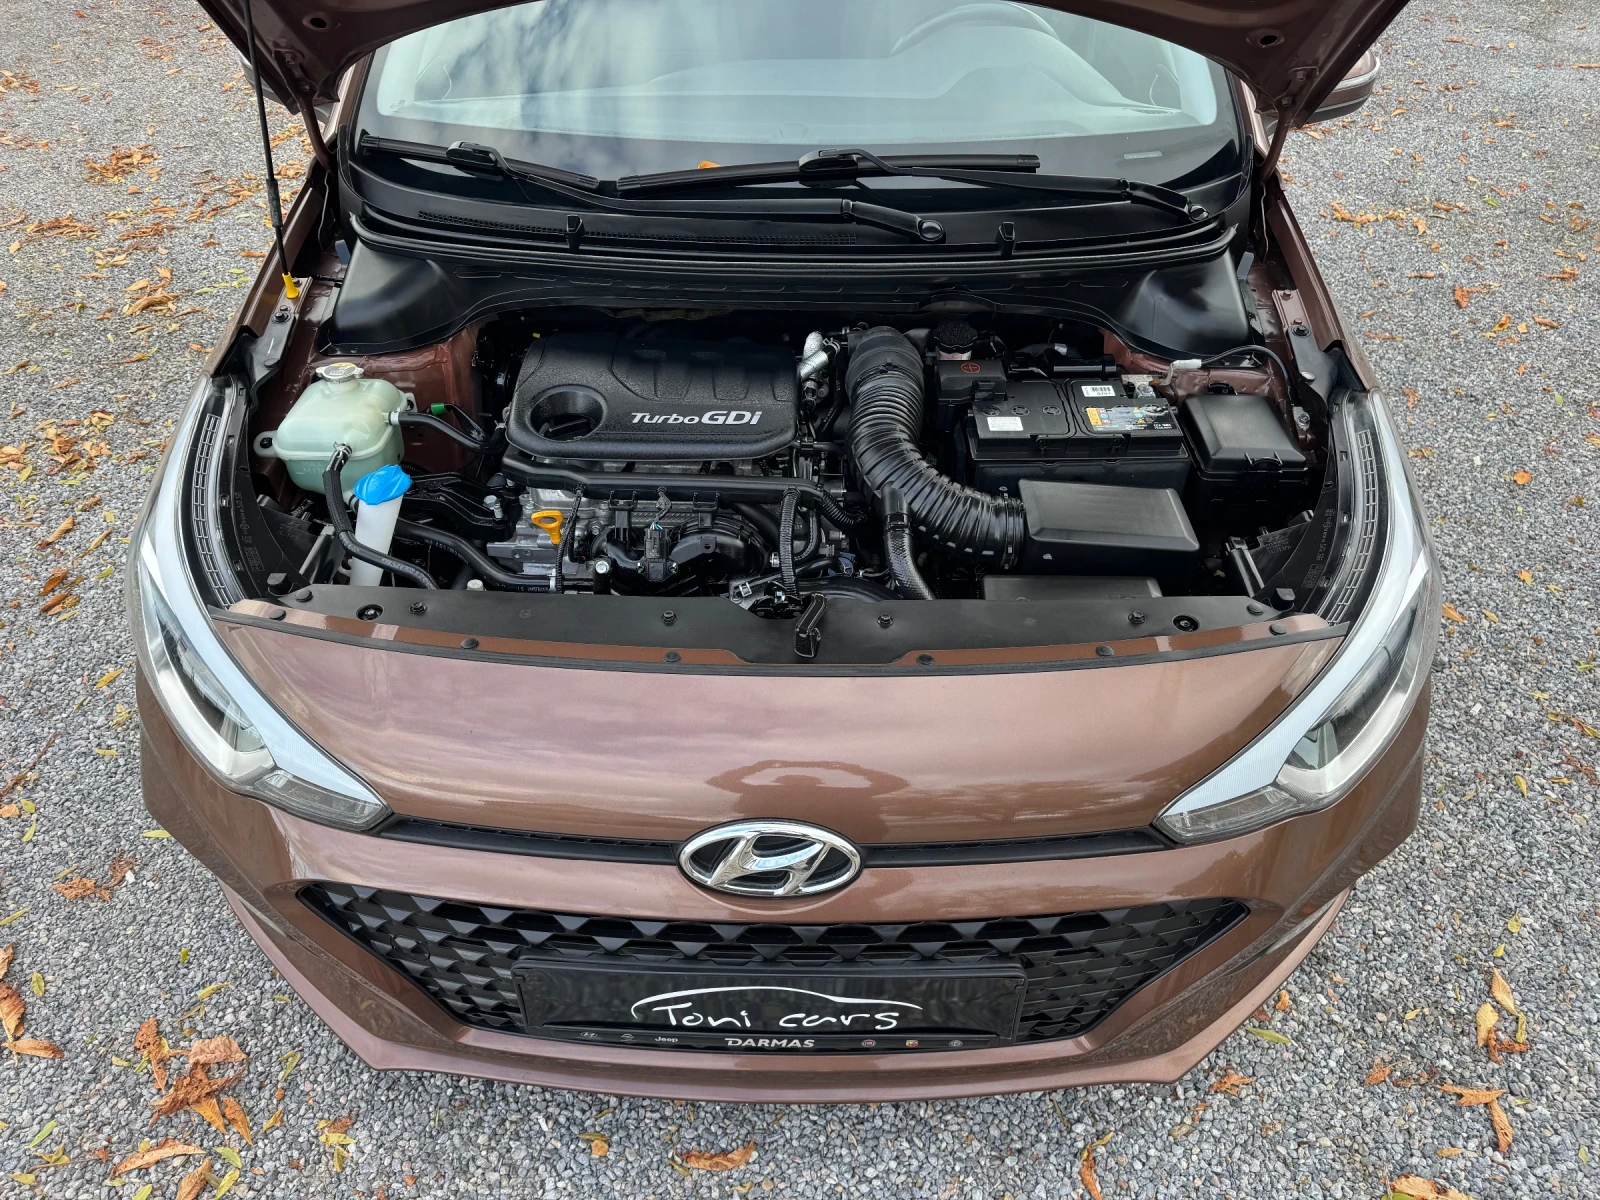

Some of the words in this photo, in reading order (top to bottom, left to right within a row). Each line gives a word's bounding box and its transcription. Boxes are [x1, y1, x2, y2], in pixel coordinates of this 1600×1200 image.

[652, 1002, 751, 1028] Toni
[778, 1012, 900, 1030] cars
[654, 1036, 679, 1044] Jeep
[724, 1037, 815, 1049] DARMAS
